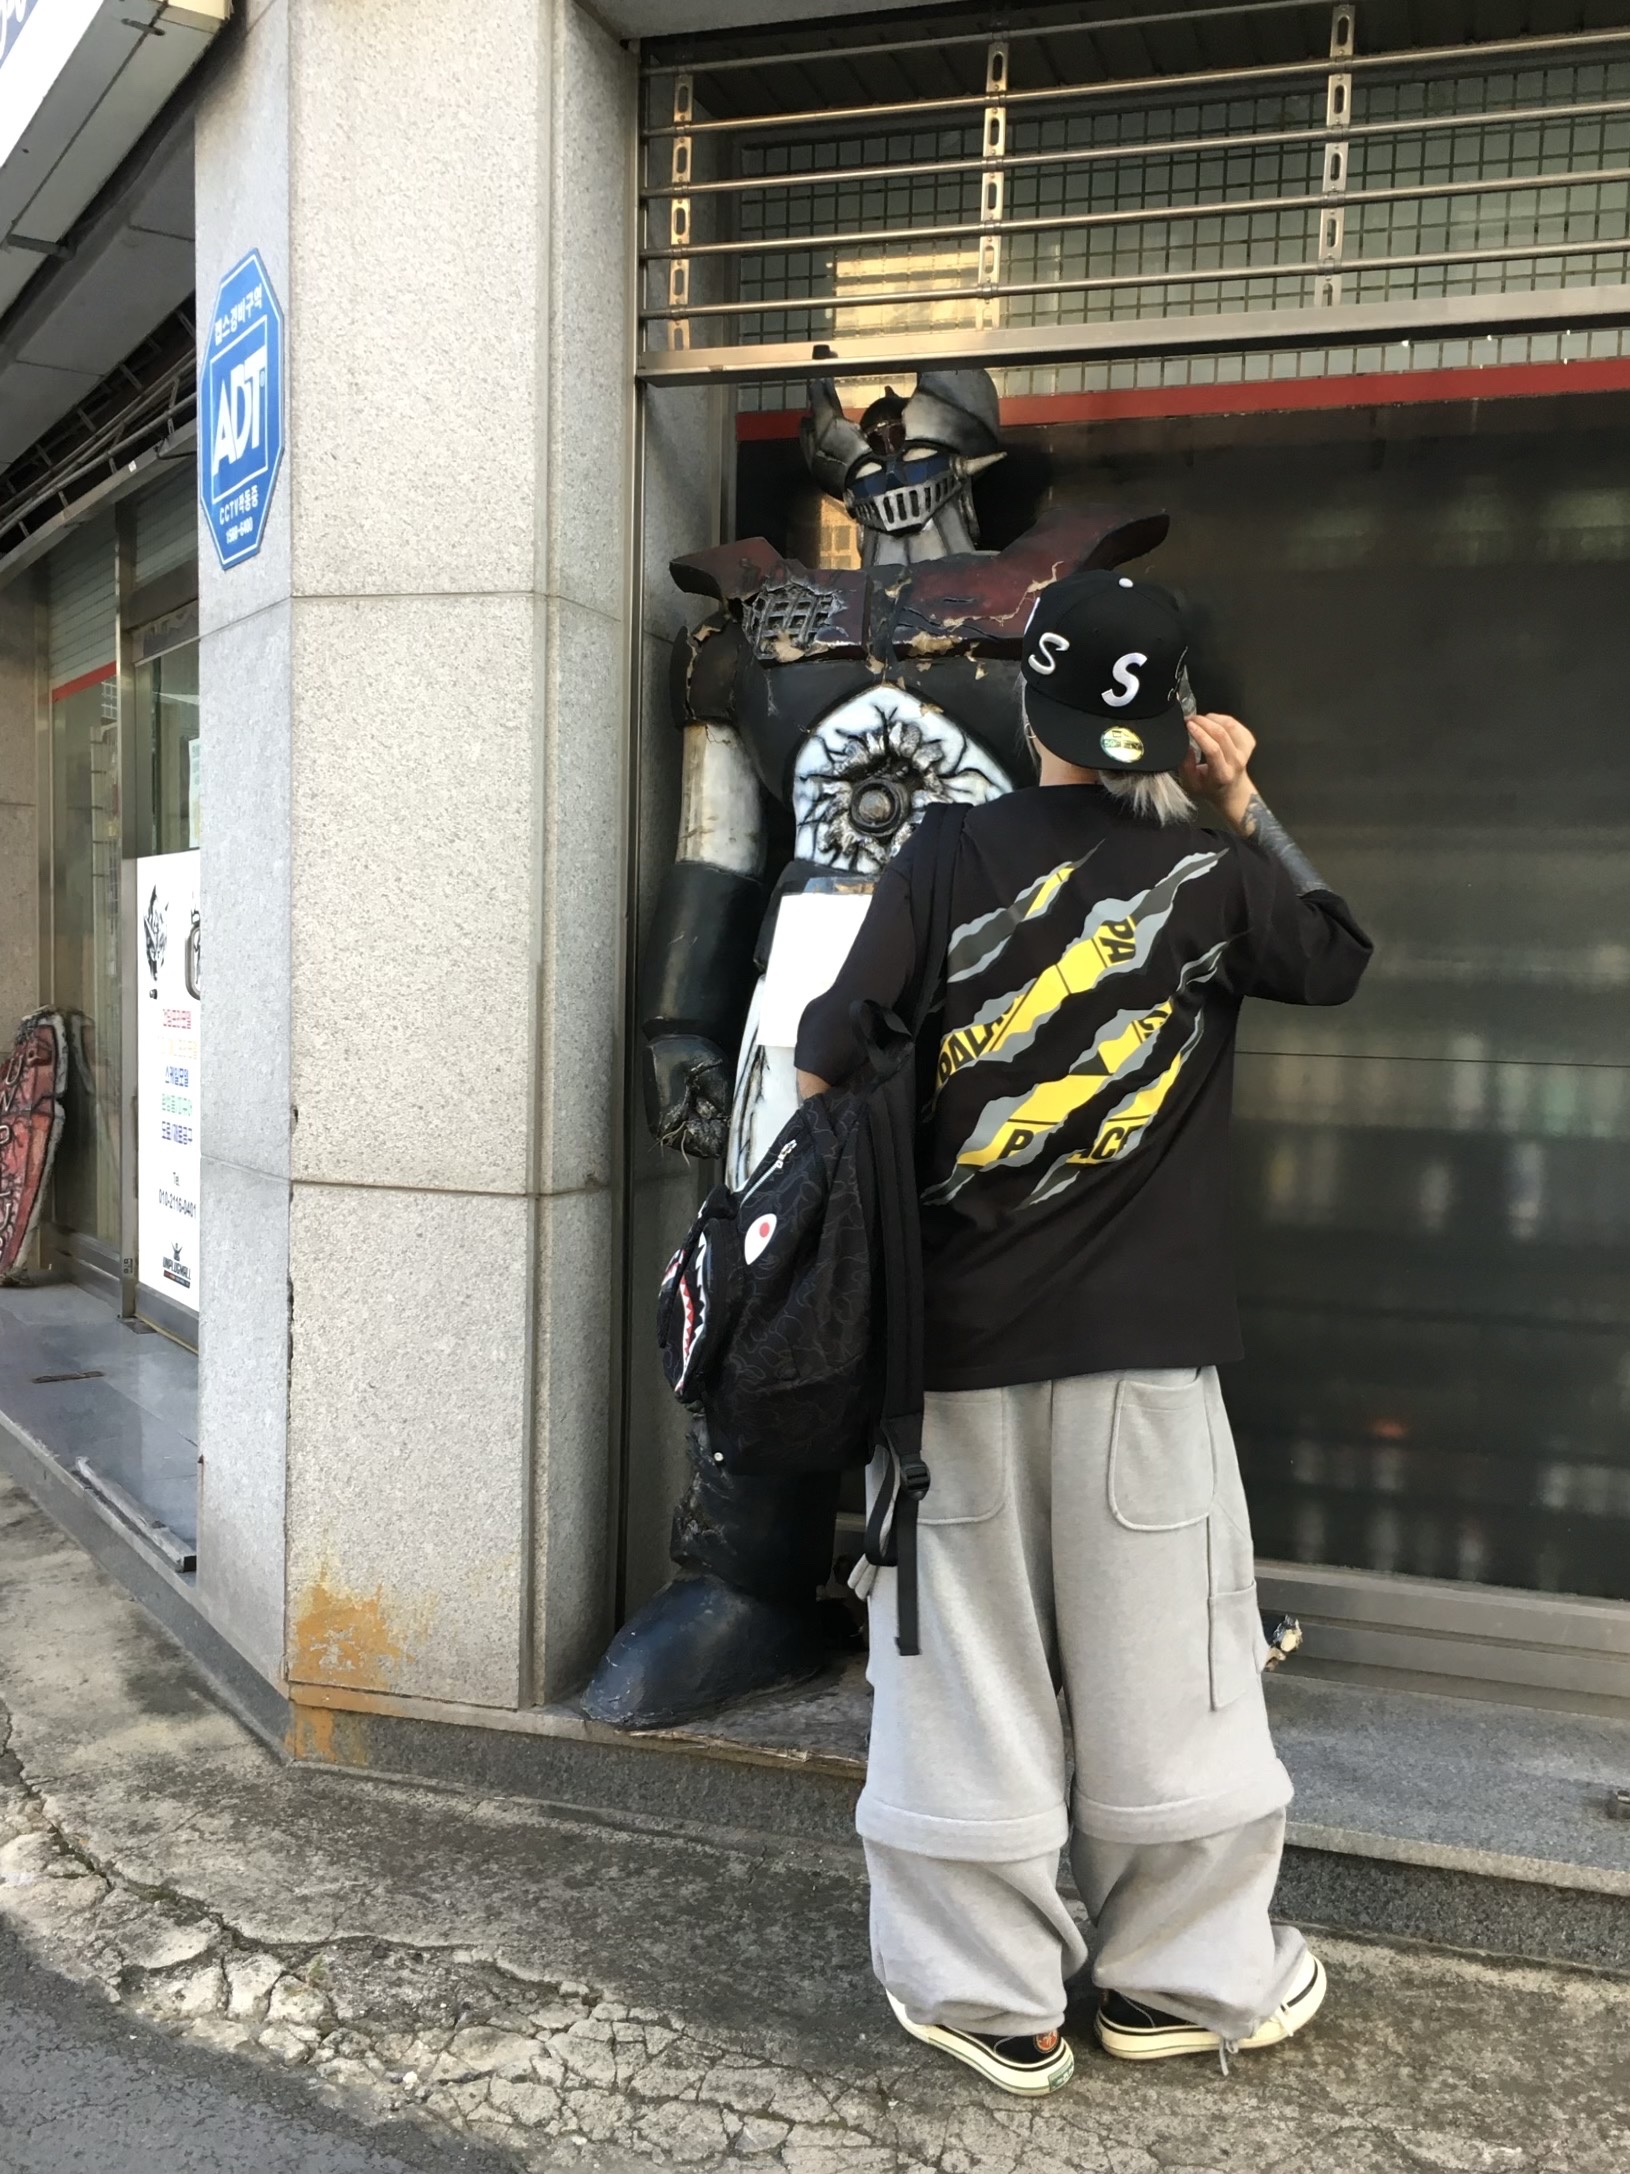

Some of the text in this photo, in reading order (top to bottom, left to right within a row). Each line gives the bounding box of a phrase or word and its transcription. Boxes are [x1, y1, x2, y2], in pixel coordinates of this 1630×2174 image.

[212, 344, 266, 477] ADT
[1028, 632, 1070, 675] S
[1101, 652, 1148, 708] S
